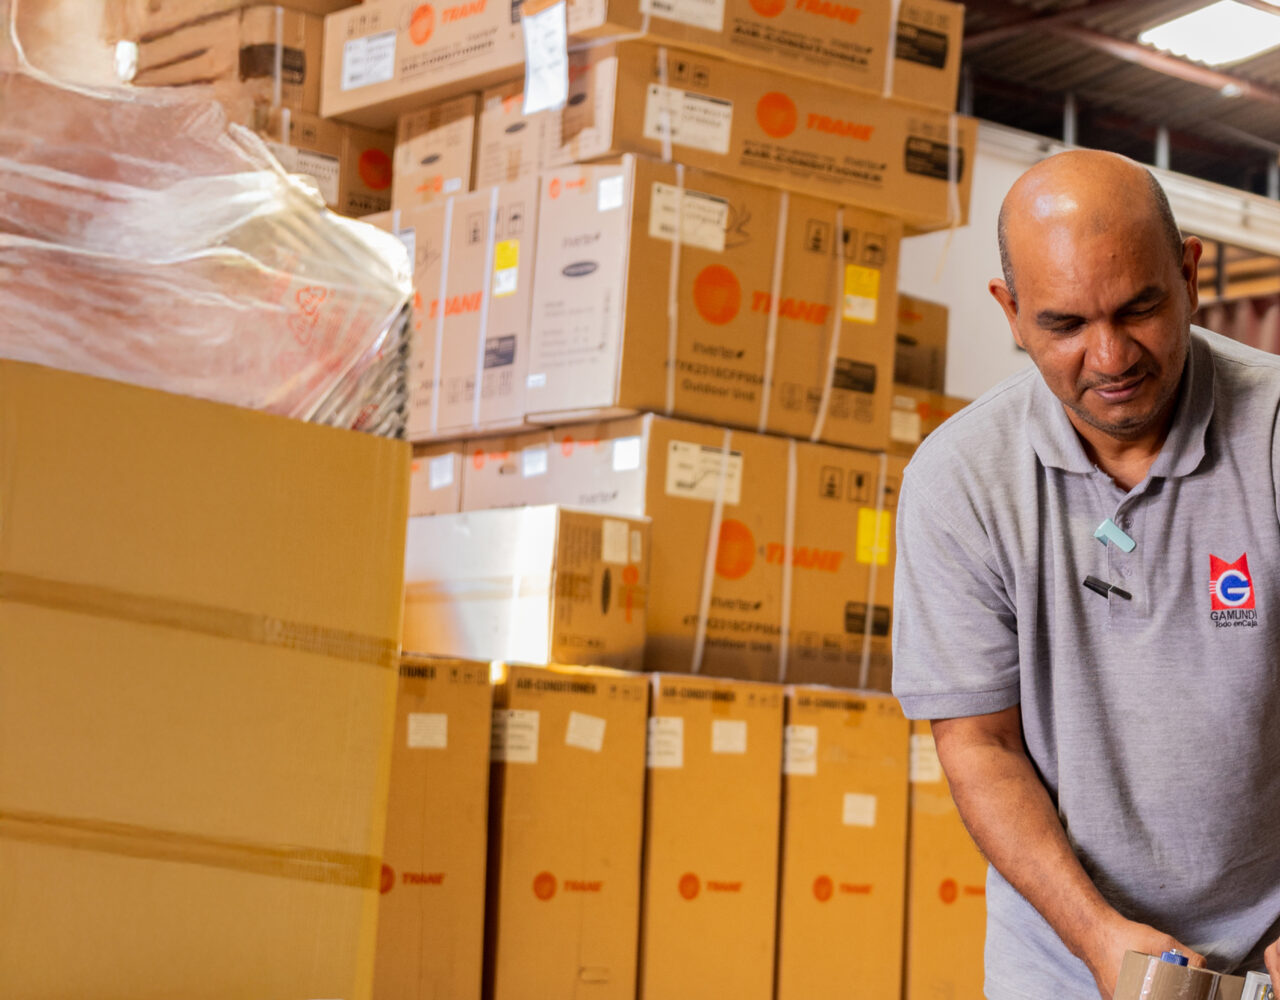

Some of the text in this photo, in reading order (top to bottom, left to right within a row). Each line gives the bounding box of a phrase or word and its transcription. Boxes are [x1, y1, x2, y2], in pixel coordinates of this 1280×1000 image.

[806, 112, 875, 142] TRANE
[1210, 609, 1258, 621] GAMUNDI
[1214, 620, 1232, 628] Todo
[402, 872, 446, 885] TRANE
[563, 880, 604, 892] TRANE
